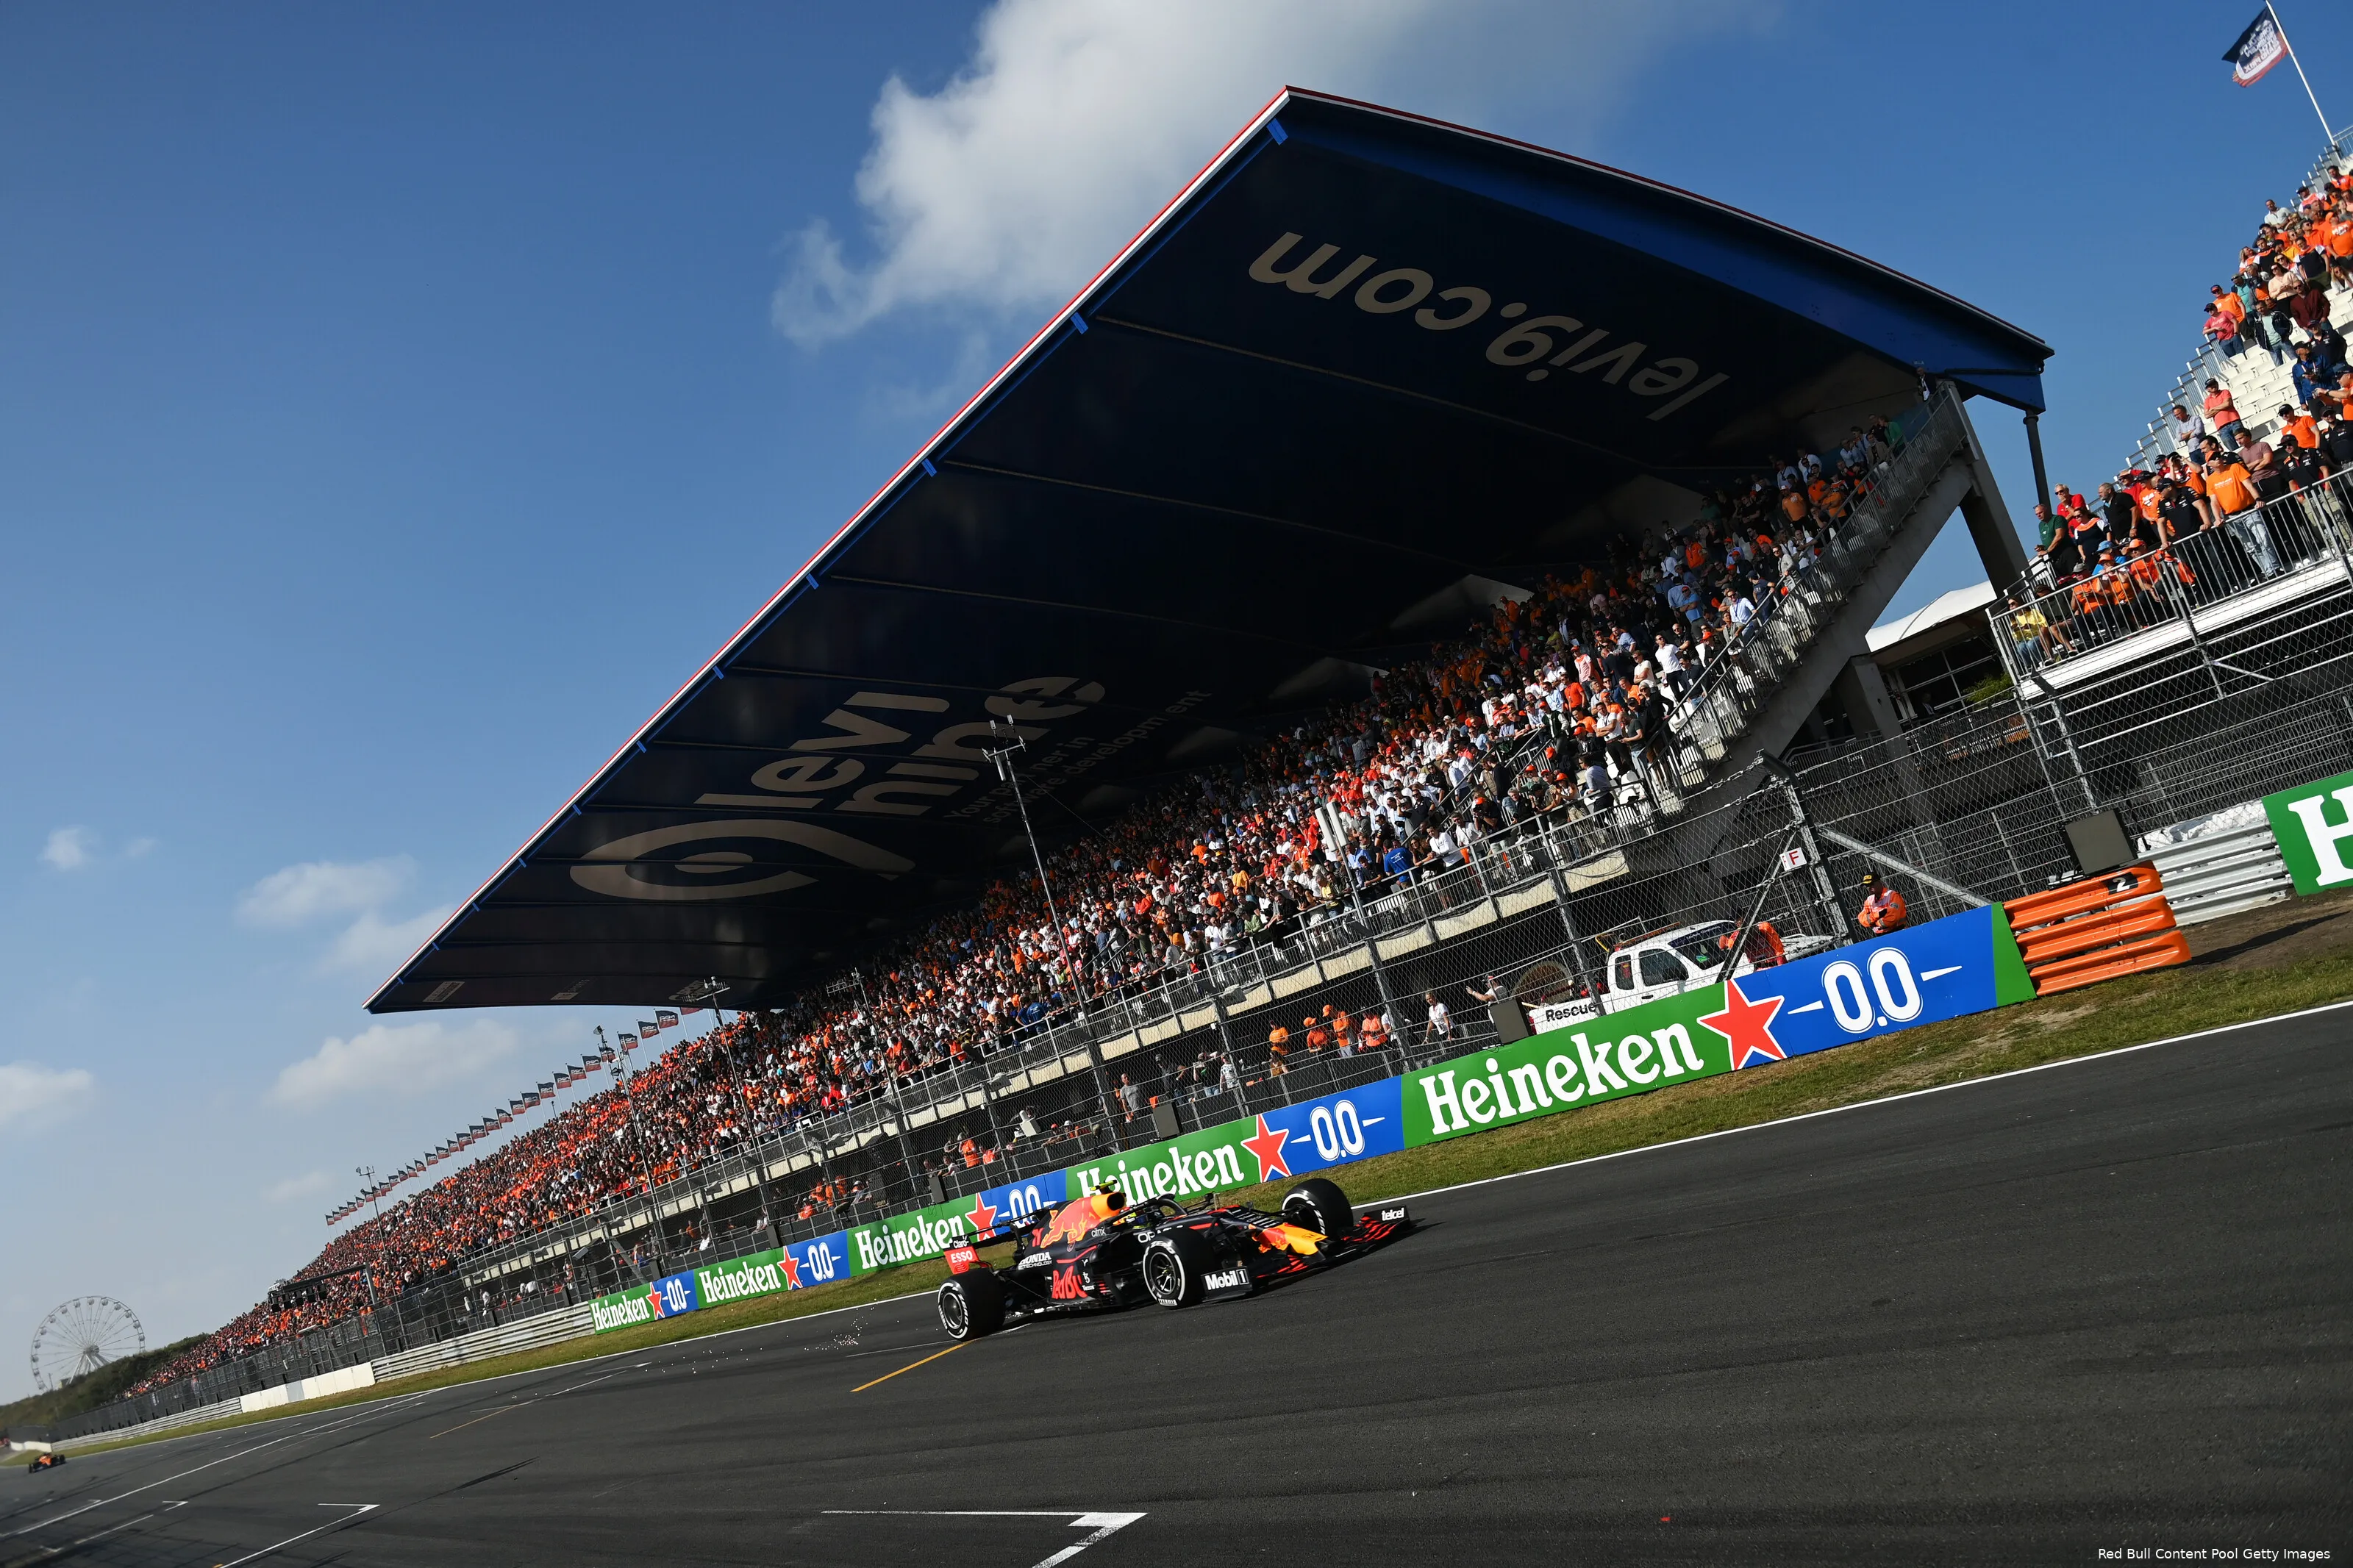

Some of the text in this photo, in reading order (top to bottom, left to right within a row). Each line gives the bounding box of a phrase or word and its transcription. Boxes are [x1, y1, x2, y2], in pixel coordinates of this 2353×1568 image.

[1249, 232, 1730, 422] levi9.com
[695, 691, 950, 809] levi
[835, 676, 1106, 817] nine
[943, 795, 996, 819] Your
[1056, 736, 1096, 749] in
[1788, 850, 1799, 865] F
[2113, 877, 2130, 892] 2
[1546, 1003, 1596, 1022] Rescue
[1419, 1023, 1704, 1136] Heineken
[1382, 1208, 1404, 1221] telcel
[854, 1214, 965, 1270] Heineken
[950, 1250, 973, 1264] ESSO
[953, 1238, 968, 1248] Claro
[699, 1261, 781, 1304] Heineken
[1204, 1270, 1238, 1290] Mobil
[590, 1295, 650, 1331] Heineken
